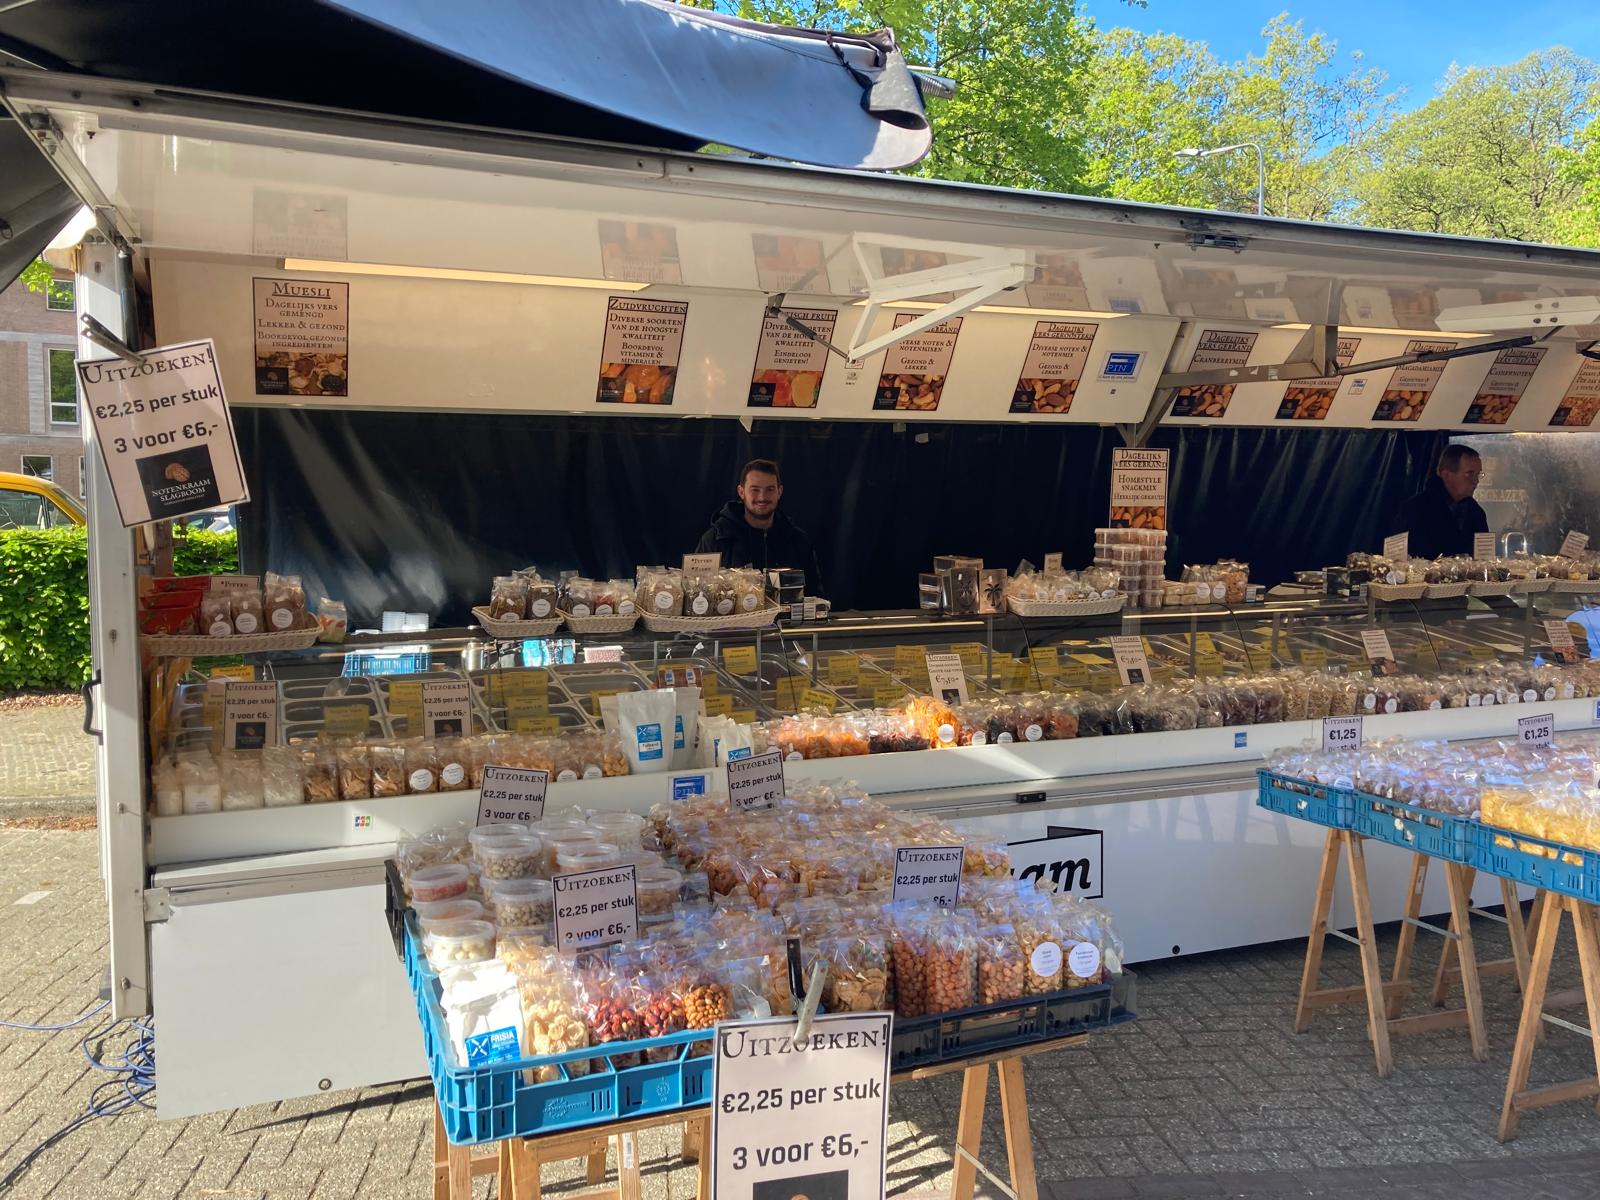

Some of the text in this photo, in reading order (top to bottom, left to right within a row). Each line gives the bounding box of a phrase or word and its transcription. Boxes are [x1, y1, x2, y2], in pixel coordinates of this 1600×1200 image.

[272, 281, 332, 297] MUESLI
[265, 298, 339, 311] DAGELIJKS VERS
[609, 298, 687, 314] ZUIDVRUCHTEN
[258, 319, 345, 331] LEKKER & GEZOND
[609, 313, 683, 326] DIVERSE SOORTEN
[764, 321, 796, 331] DIVERS
[622, 333, 666, 341] KWALITEIT
[642, 326, 679, 334] HOOGSTE
[80, 347, 214, 385] UITZOEKEN!
[95, 383, 219, 420] €2,25 per stuk
[114, 421, 219, 454] 3 voor €6,-
[1121, 449, 1162, 461] DAGELIJKS
[1118, 474, 1161, 483] HOMESTYLE
[151, 478, 211, 497] NOTENKRAAM
[159, 486, 206, 502] SLAGBOOM
[1329, 728, 1357, 741] €1,25
[1524, 726, 1549, 740] €1,25
[752, 777, 765, 786] per
[766, 772, 782, 783] stuk
[508, 792, 522, 801] per
[524, 792, 543, 802] stuk
[735, 798, 742, 807] 3
[484, 809, 491, 818] 3
[493, 810, 516, 820] voor
[554, 868, 636, 892] UITZOEKEN!
[897, 873, 958, 885] €2,25 per stuk
[558, 895, 634, 918] €2,25 per stuk
[576, 928, 605, 941] voor
[607, 922, 631, 935] €6,-
[720, 1022, 888, 1059] UITZOEKEN!
[721, 1077, 882, 1115] €2,25 per stuk
[732, 1133, 869, 1170] 3 voor €6,-
